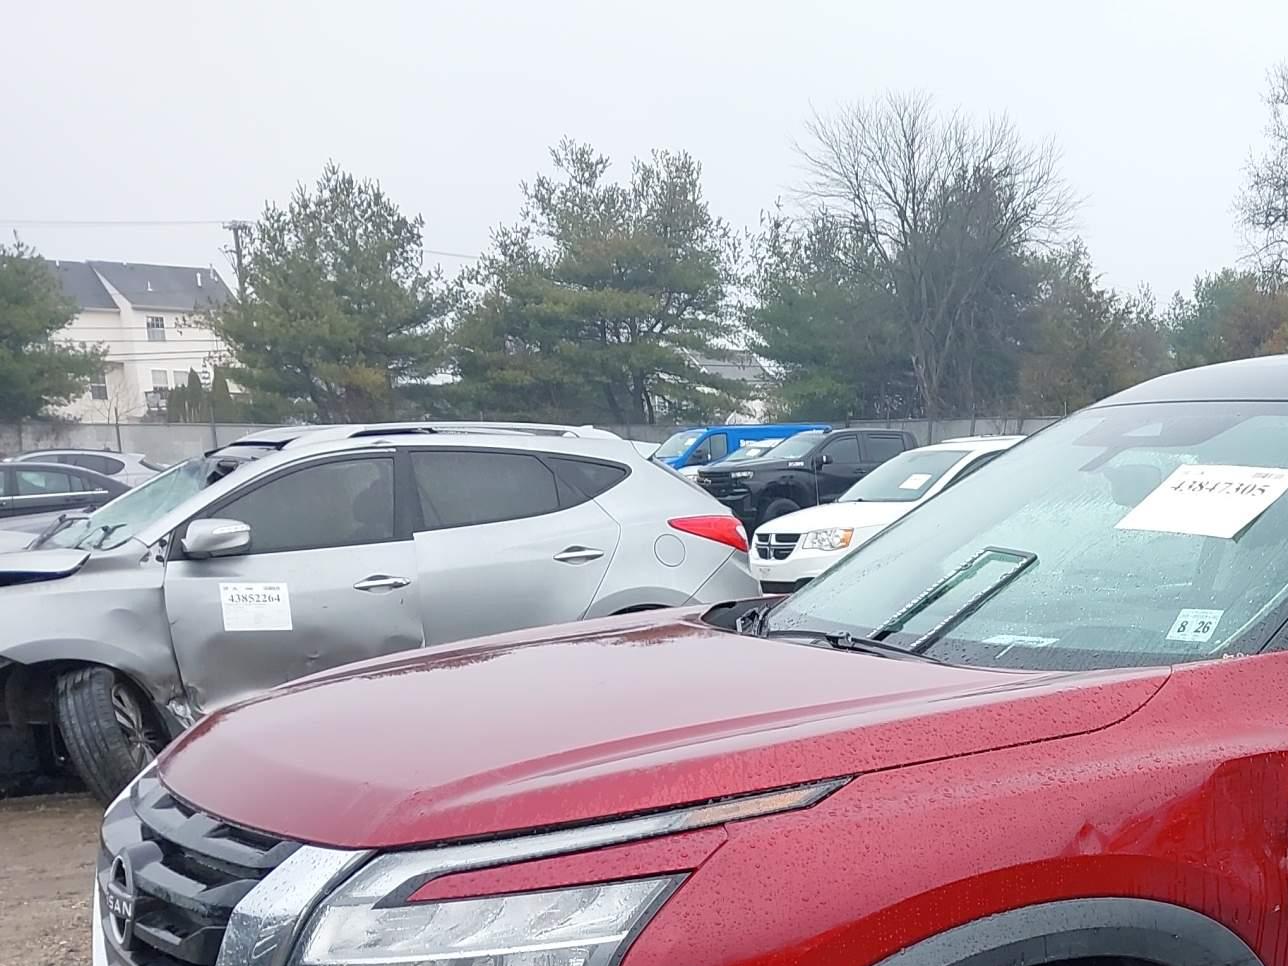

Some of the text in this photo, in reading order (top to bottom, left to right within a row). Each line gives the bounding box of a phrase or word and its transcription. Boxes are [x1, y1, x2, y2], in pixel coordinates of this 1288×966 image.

[1171, 479, 1271, 496] 43847305
[228, 593, 281, 603] 43852264
[1177, 620, 1212, 634] 8 26
